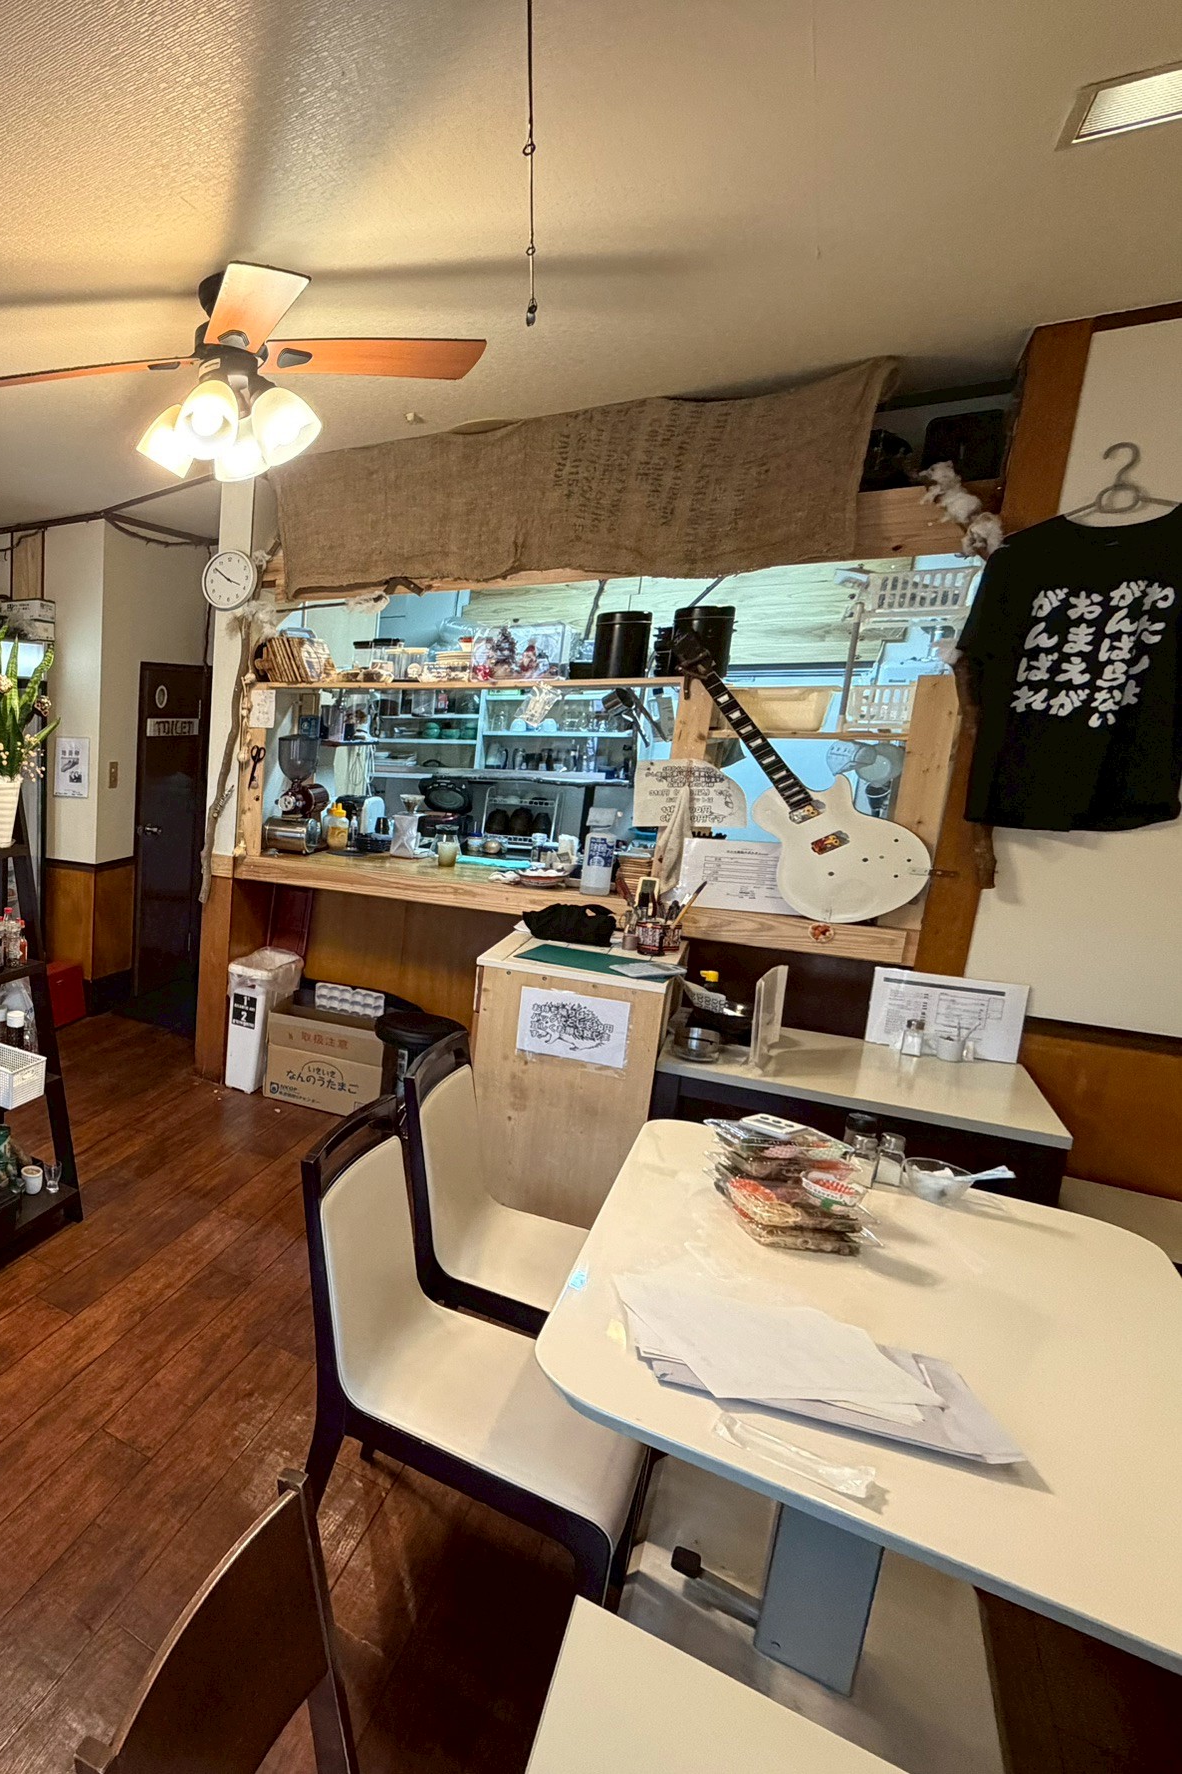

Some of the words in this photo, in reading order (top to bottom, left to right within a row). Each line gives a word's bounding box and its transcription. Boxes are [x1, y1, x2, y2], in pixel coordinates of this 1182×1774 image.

[1009, 588, 1070, 713] がんばれ
[1048, 590, 1105, 717] おまえが
[1088, 580, 1149, 729] がんばらない
[156, 720, 193, 736] TOILET
[300, 1030, 349, 1050] 取扱注意
[286, 1069, 360, 1095] なんのうたまご
